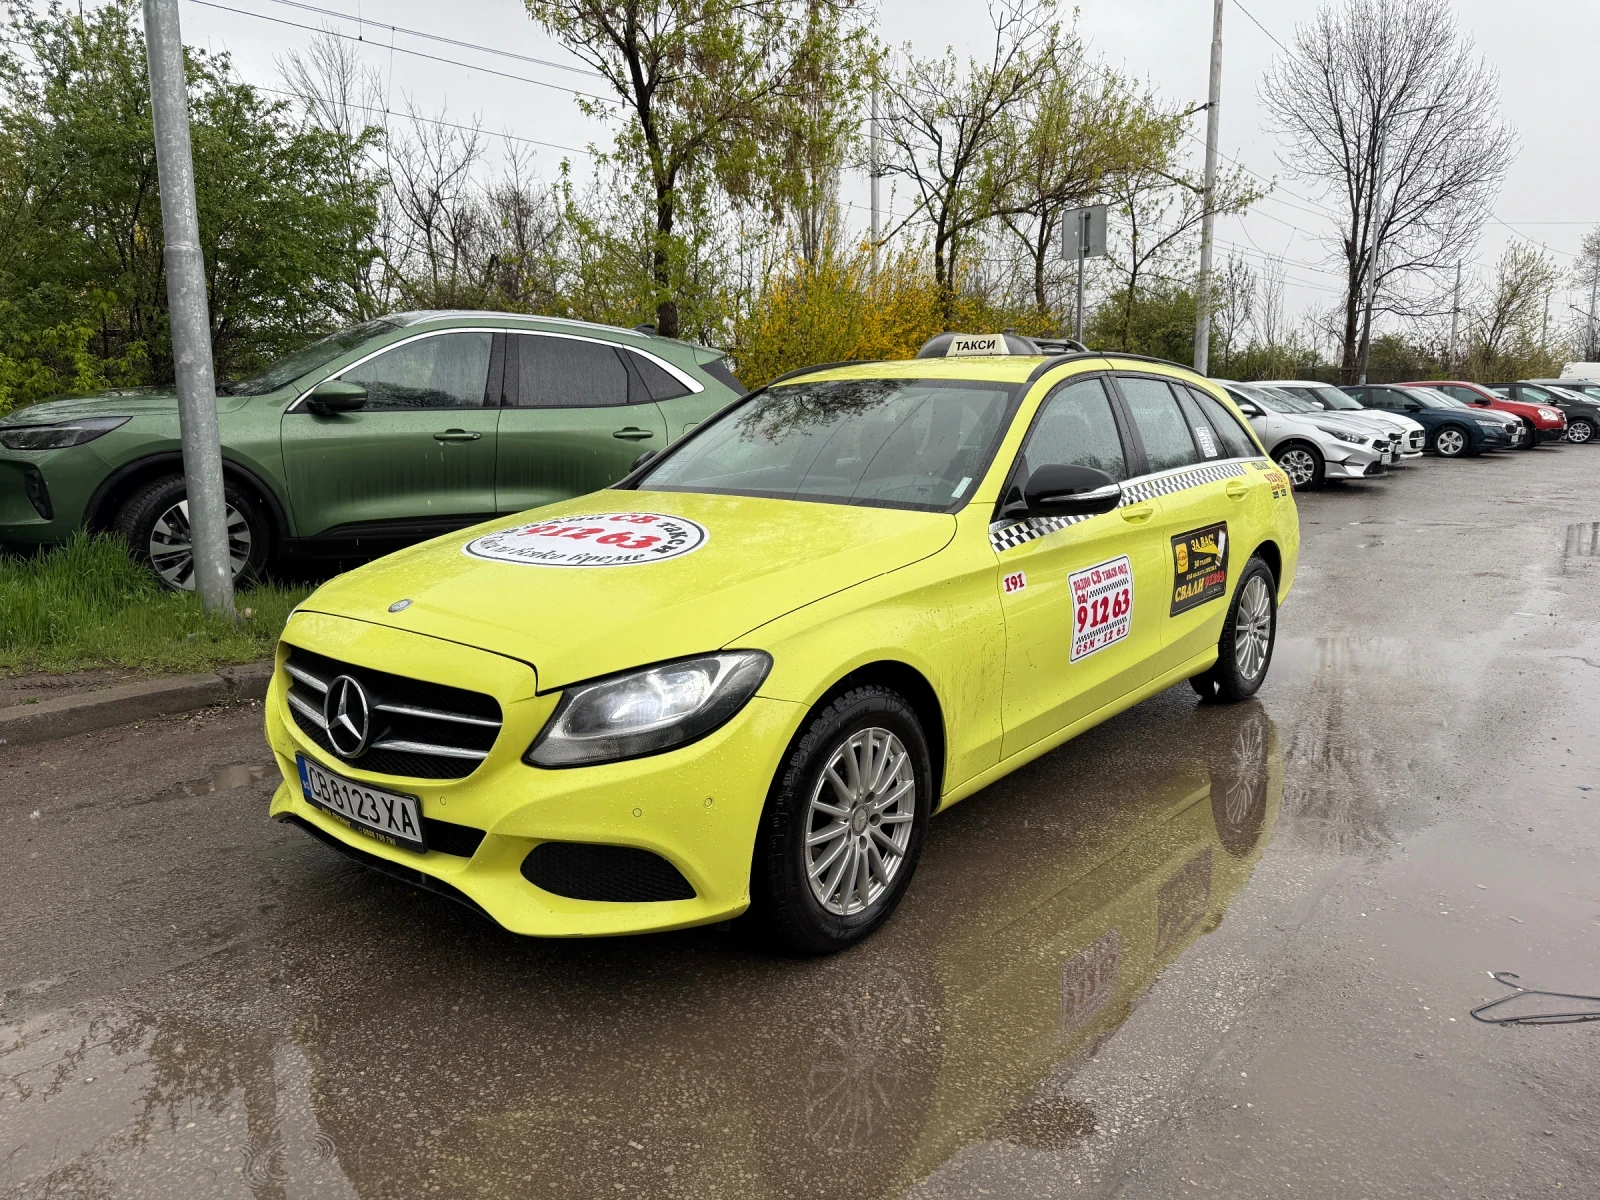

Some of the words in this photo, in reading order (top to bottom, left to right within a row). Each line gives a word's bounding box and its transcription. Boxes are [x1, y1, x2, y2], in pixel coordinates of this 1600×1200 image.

[955, 339, 996, 351] ТАКСИ
[651, 522, 689, 554] такси
[1004, 573, 1025, 592] 191
[1076, 637, 1096, 655] GSM
